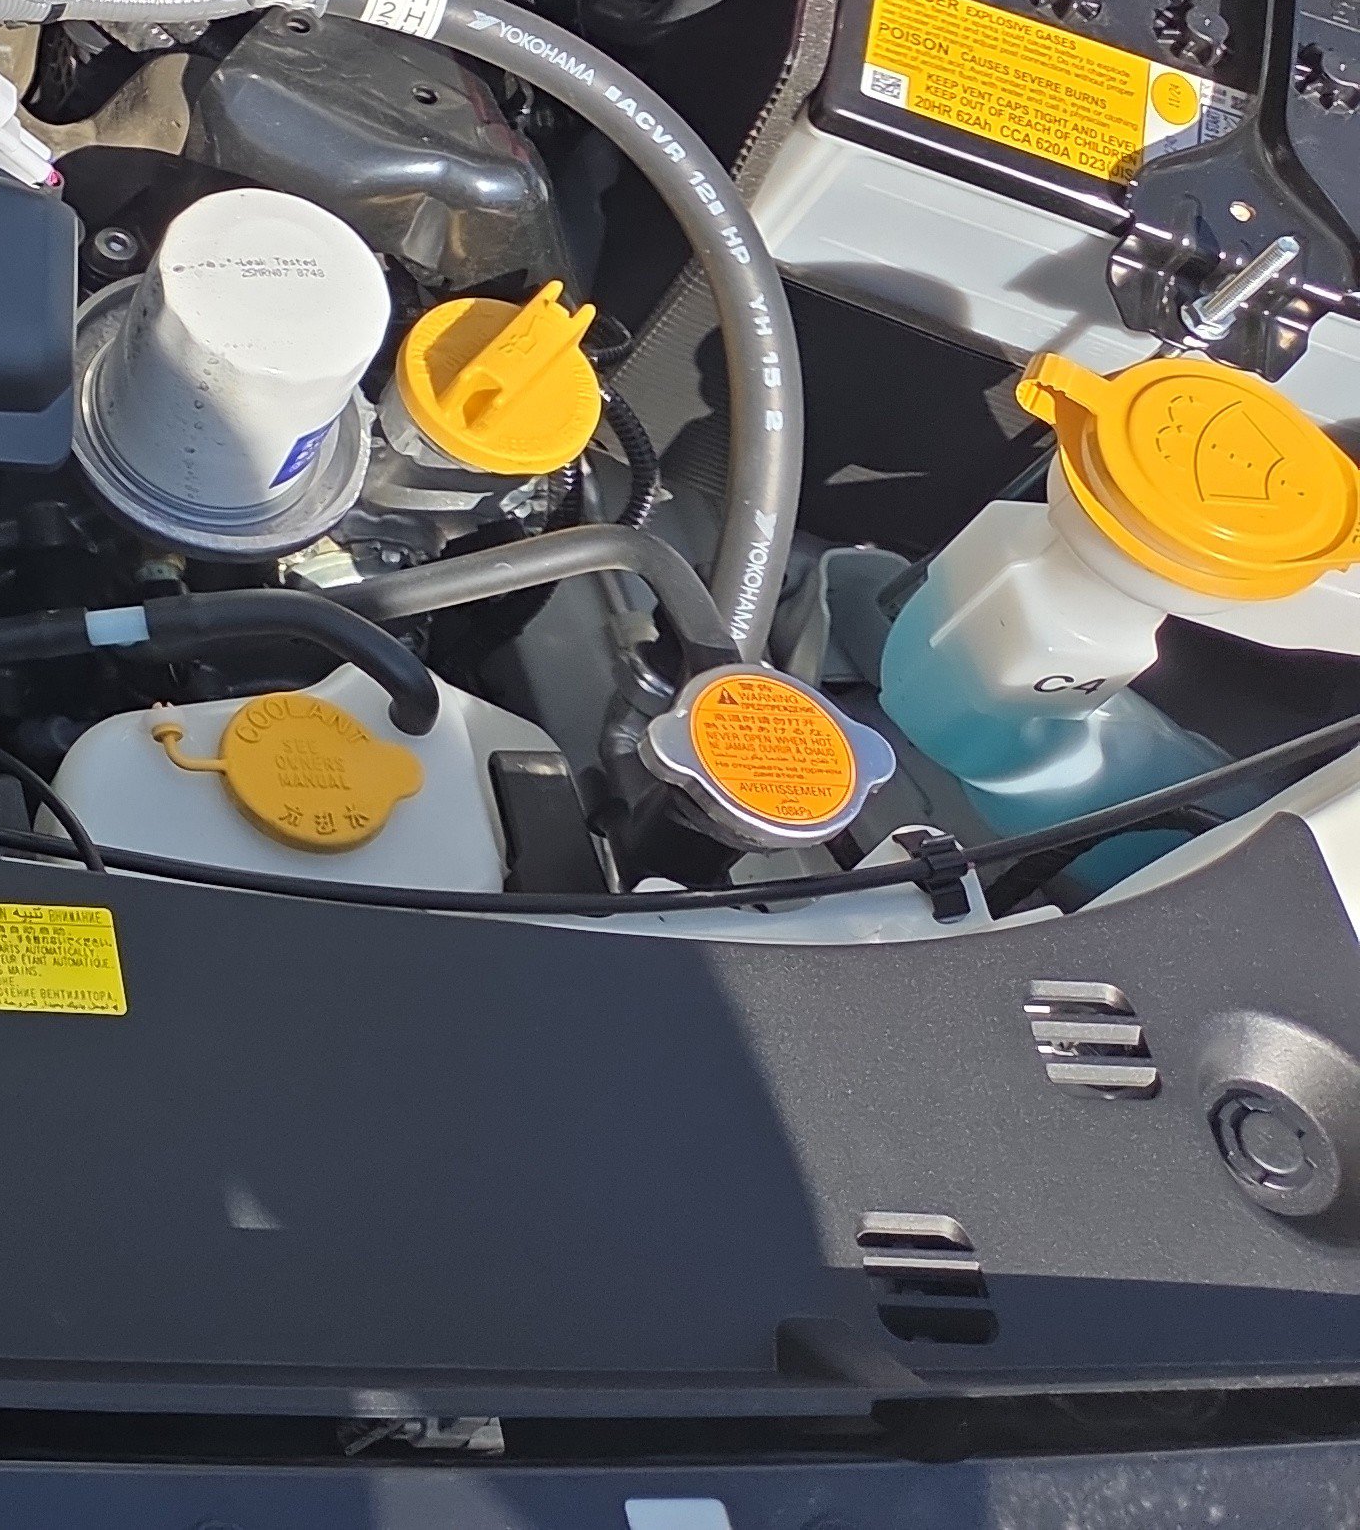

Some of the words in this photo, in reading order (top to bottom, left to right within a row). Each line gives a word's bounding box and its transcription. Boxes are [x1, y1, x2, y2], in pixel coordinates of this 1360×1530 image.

[965, 5, 1031, 36] EXPLOSIVE
[1035, 28, 1076, 51] GASES
[499, 22, 596, 86] YOKOHAMA
[878, 21, 950, 56] POISON
[960, 50, 1010, 76] CAUSES
[1012, 68, 1062, 93] SEVERE
[1064, 86, 1107, 110] BURNS
[913, 94, 952, 119] 20HR
[955, 108, 992, 132] 62Ah
[999, 123, 1032, 146] CCA
[1034, 136, 1071, 160] 620A
[924, 83, 956, 103] KEEP
[959, 95, 985, 113] OUT
[987, 105, 1005, 120] OF
[1007, 111, 1051, 136] REACH
[1053, 127, 1070, 142] OF
[1073, 134, 1137, 166] CHILDREN
[926, 71, 959, 91] KEEP
[960, 83, 993, 103] VENT
[995, 95, 1030, 116] CAPS
[1032, 108, 1069, 130] TIGHT
[1070, 121, 1097, 140] AND
[273, 256, 317, 267] Tested
[719, 226, 751, 265] HP
[749, 292, 774, 336] YH
[730, 540, 771, 641] YOKOHAMA
[738, 690, 798, 704] WARNING
[1033, 674, 1108, 696] C4
[235, 696, 370, 745] COOLANT
[705, 730, 739, 740] NEVER
[743, 732, 771, 743] OPEN
[775, 735, 807, 745] WHEN
[811, 737, 831, 747] HOT
[278, 771, 352, 790] MANUAL
[739, 781, 832, 798] AVERTISSEMENT
